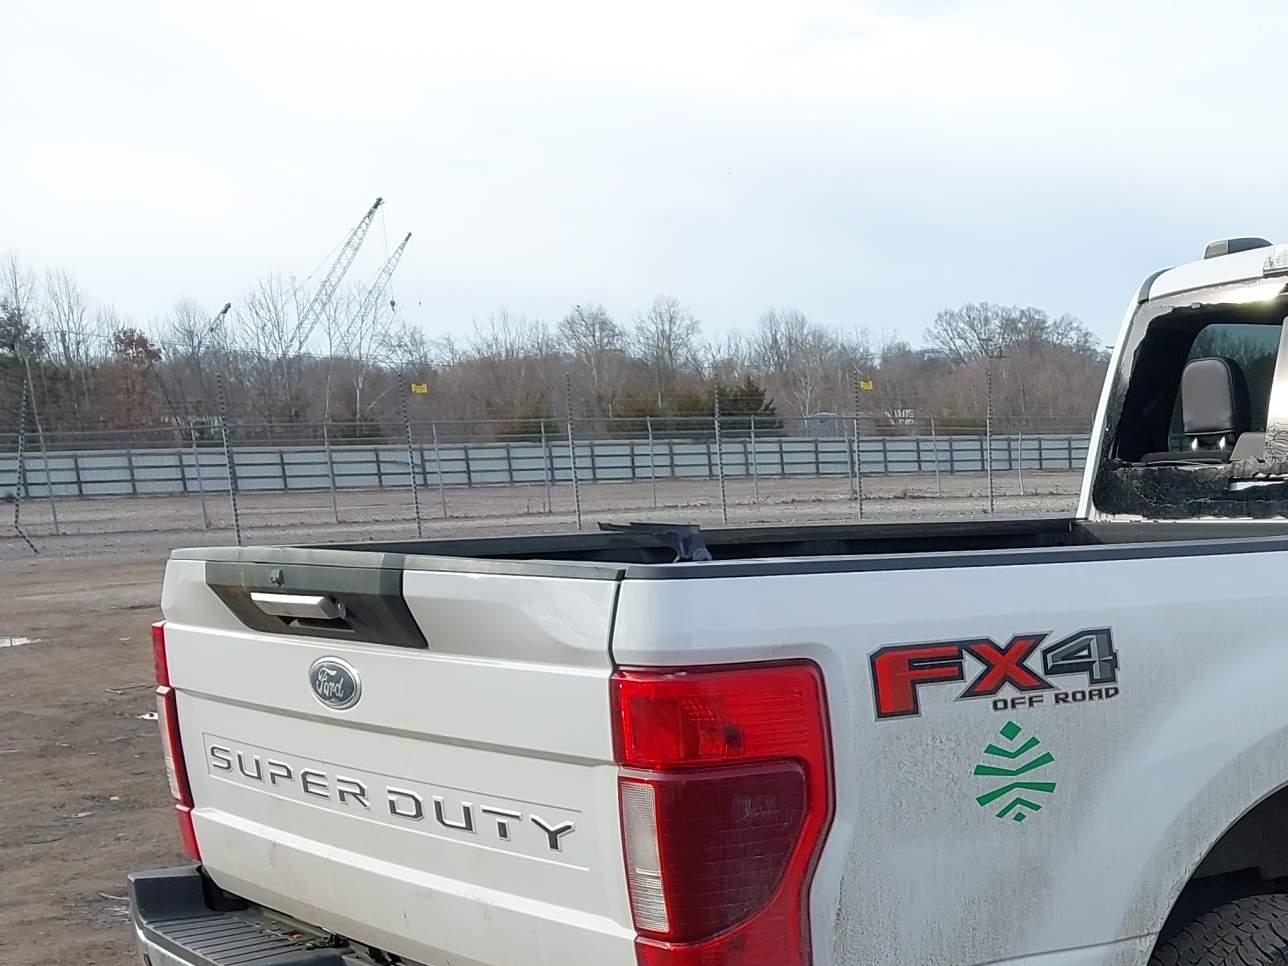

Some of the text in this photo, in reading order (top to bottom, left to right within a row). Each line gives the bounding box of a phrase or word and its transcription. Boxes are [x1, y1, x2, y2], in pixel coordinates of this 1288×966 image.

[315, 667, 344, 697] Ford
[868, 627, 1119, 720] FX4
[992, 686, 1119, 712] OFF ROAD
[209, 744, 575, 851] SUPER DUTY
